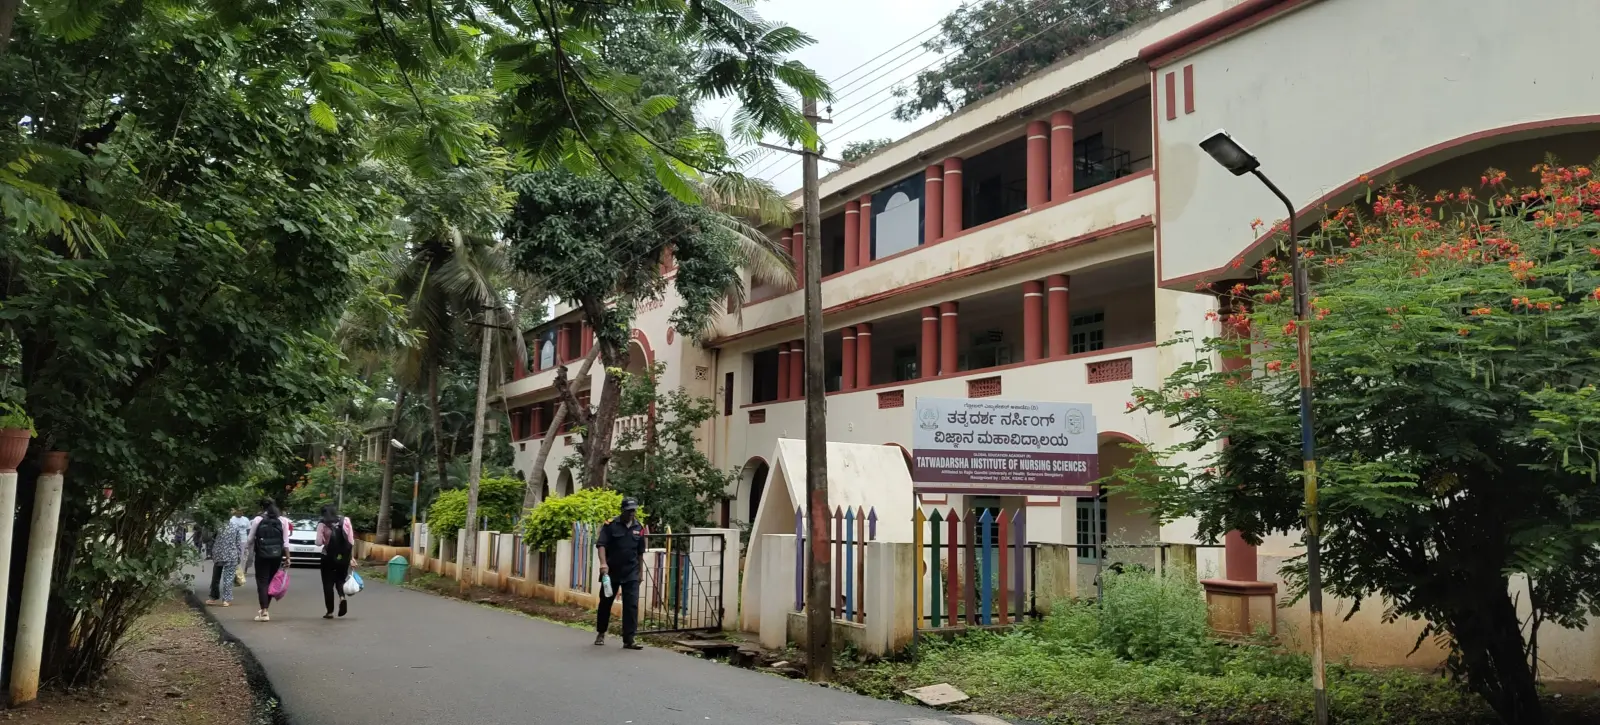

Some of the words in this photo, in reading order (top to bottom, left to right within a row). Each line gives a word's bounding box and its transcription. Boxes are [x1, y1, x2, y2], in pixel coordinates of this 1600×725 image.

[947, 410, 997, 427] ತತ್ವದರ್ಶ
[1000, 412, 1055, 427] ನರ್ಸಿಂಗ್
[934, 430, 974, 448] ವಿಜ್ಞಾನ
[977, 430, 1069, 449] ಮಹಾವಿದ್ಯಾಲಯ
[916, 456, 969, 469] TATWADARSHA
[971, 458, 1007, 470] INSTITUTE
[1008, 458, 1018, 470] OF
[1020, 459, 1051, 471] NURSING
[1052, 460, 1087, 472] SCIENCES
